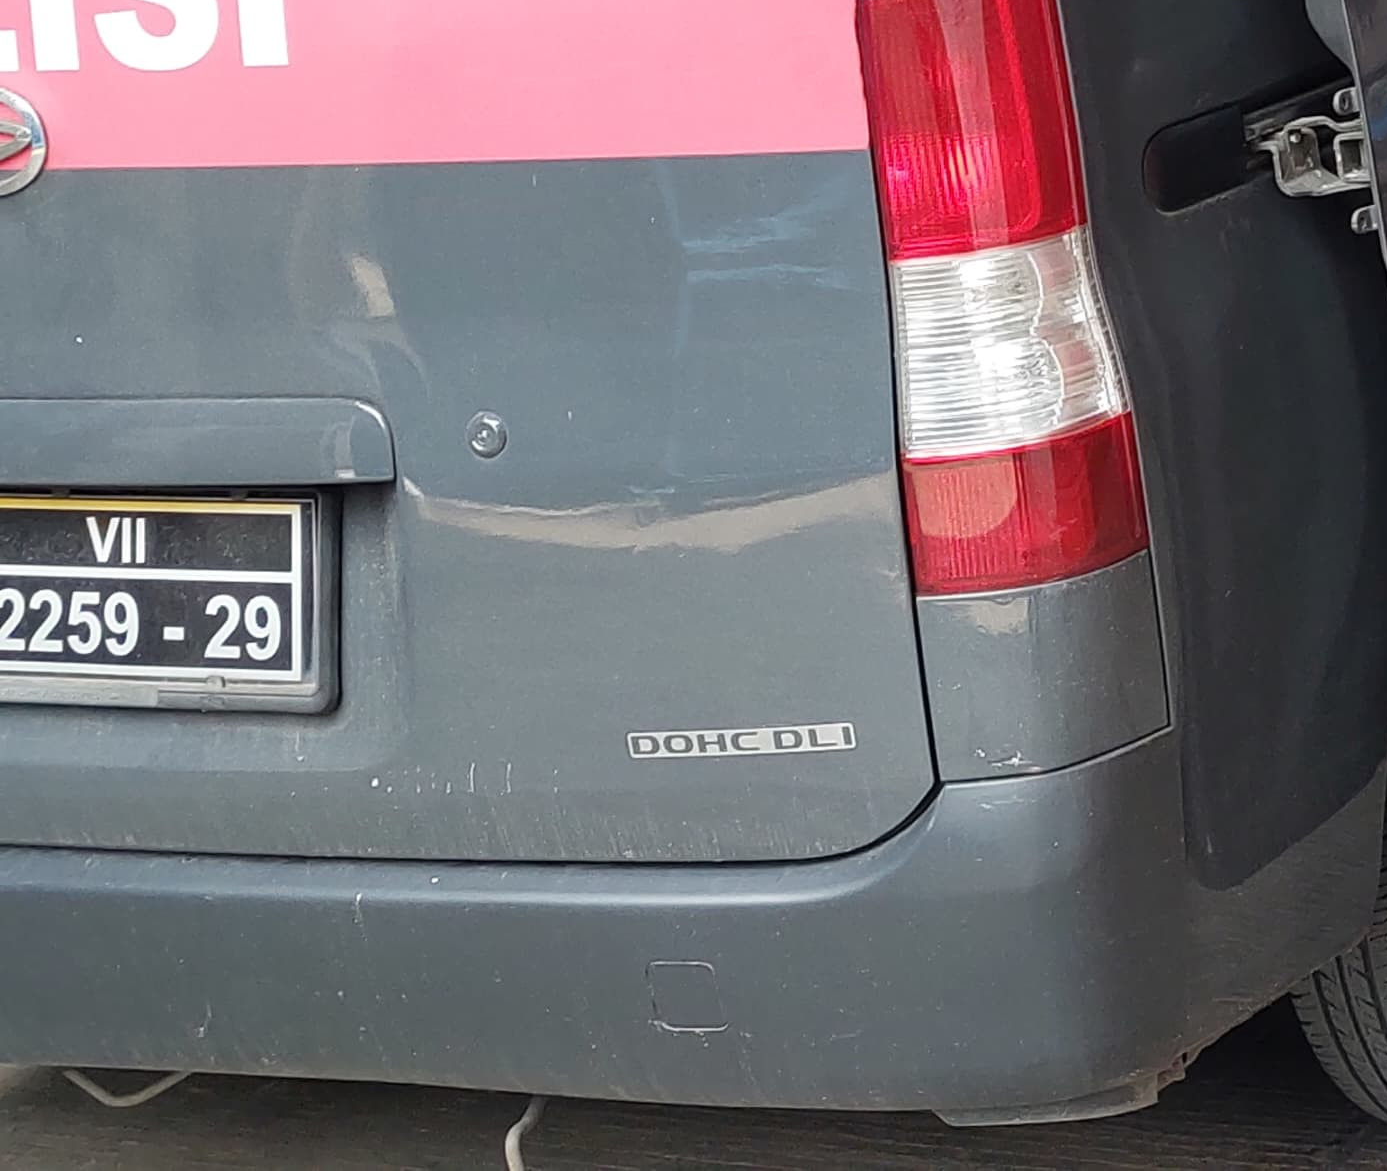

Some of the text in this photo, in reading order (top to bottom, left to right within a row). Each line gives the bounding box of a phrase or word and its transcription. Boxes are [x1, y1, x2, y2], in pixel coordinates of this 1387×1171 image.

[86, 516, 146, 564] VII
[204, 594, 281, 661] 29
[630, 725, 853, 755] DOHC DLI
